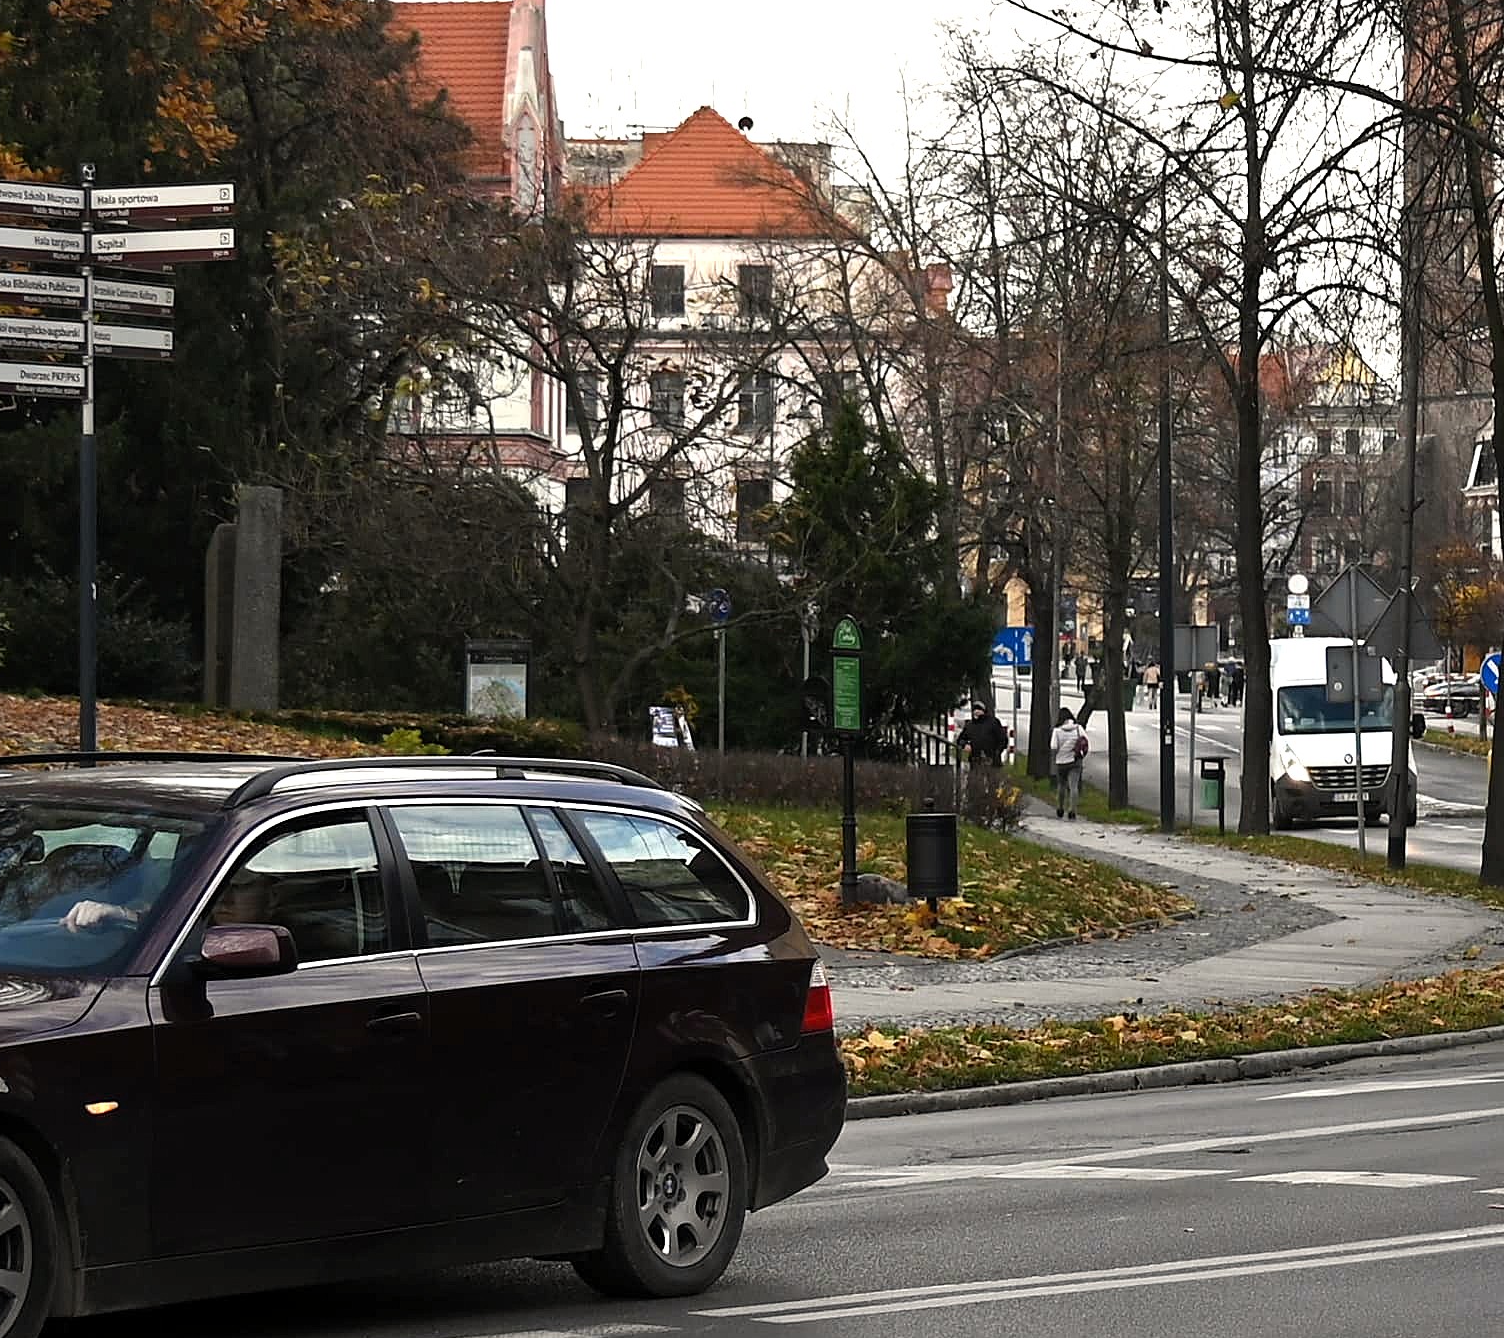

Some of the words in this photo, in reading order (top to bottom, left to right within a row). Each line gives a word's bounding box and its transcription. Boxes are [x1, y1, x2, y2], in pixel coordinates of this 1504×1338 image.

[97, 195, 116, 205] Hala
[118, 194, 159, 206] sportowa
[34, 236, 49, 246] Hala
[97, 238, 126, 250] Szpital
[20, 369, 50, 381] Dworzec
